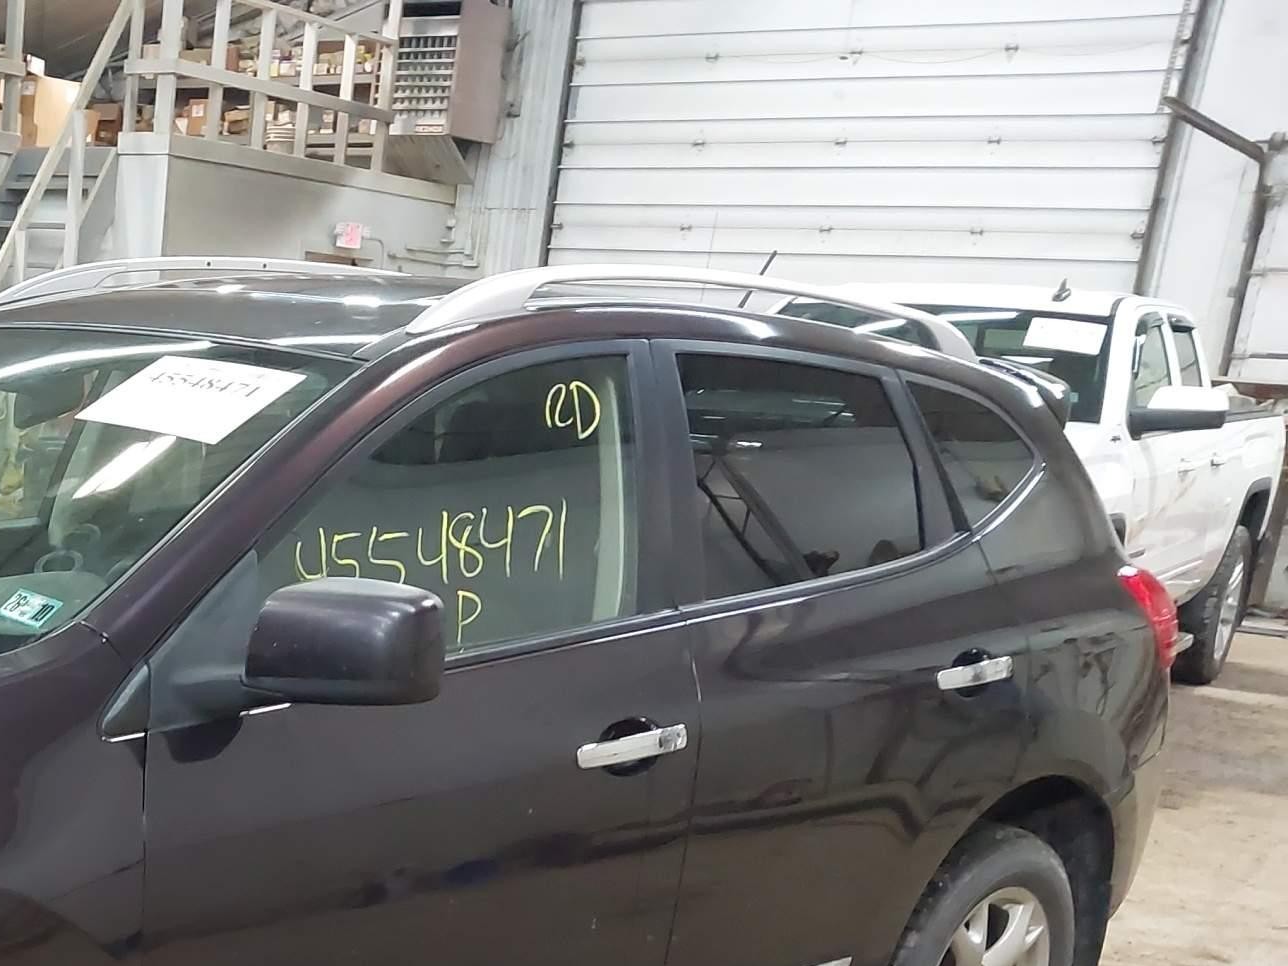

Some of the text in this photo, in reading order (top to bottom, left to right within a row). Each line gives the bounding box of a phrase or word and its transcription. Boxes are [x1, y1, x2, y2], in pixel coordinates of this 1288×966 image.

[294, 497, 568, 585] 45548471
[31, 603, 55, 622] 10
[455, 589, 483, 646] P
